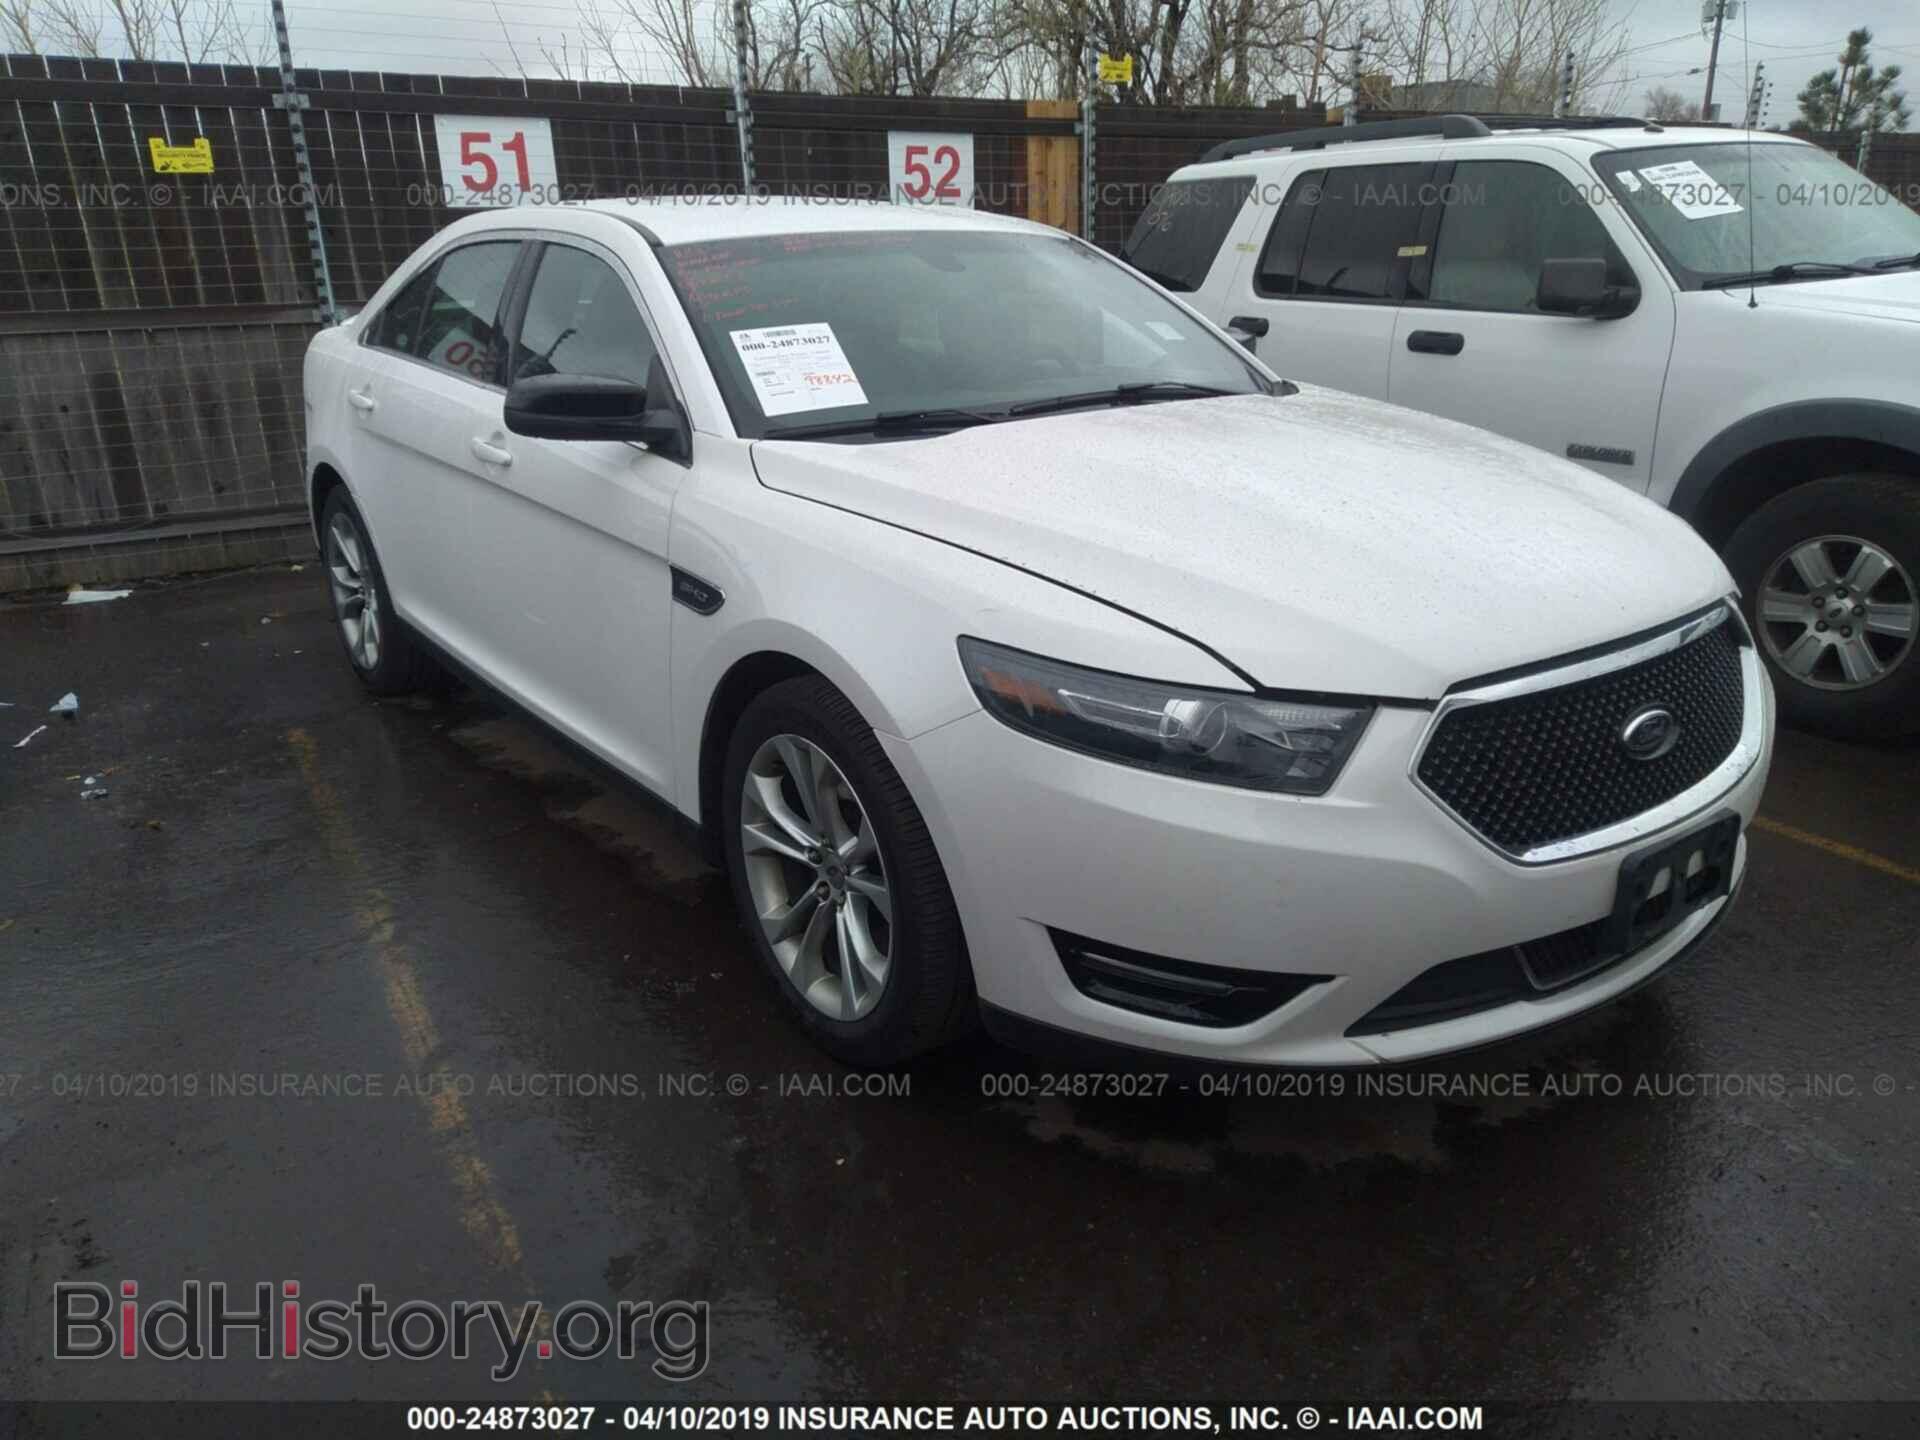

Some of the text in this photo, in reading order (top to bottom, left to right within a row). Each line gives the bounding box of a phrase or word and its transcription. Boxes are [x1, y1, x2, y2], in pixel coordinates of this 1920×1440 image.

[461, 131, 531, 193] 51
[904, 145, 961, 198] 52
[742, 335, 830, 351] 000-24873027
